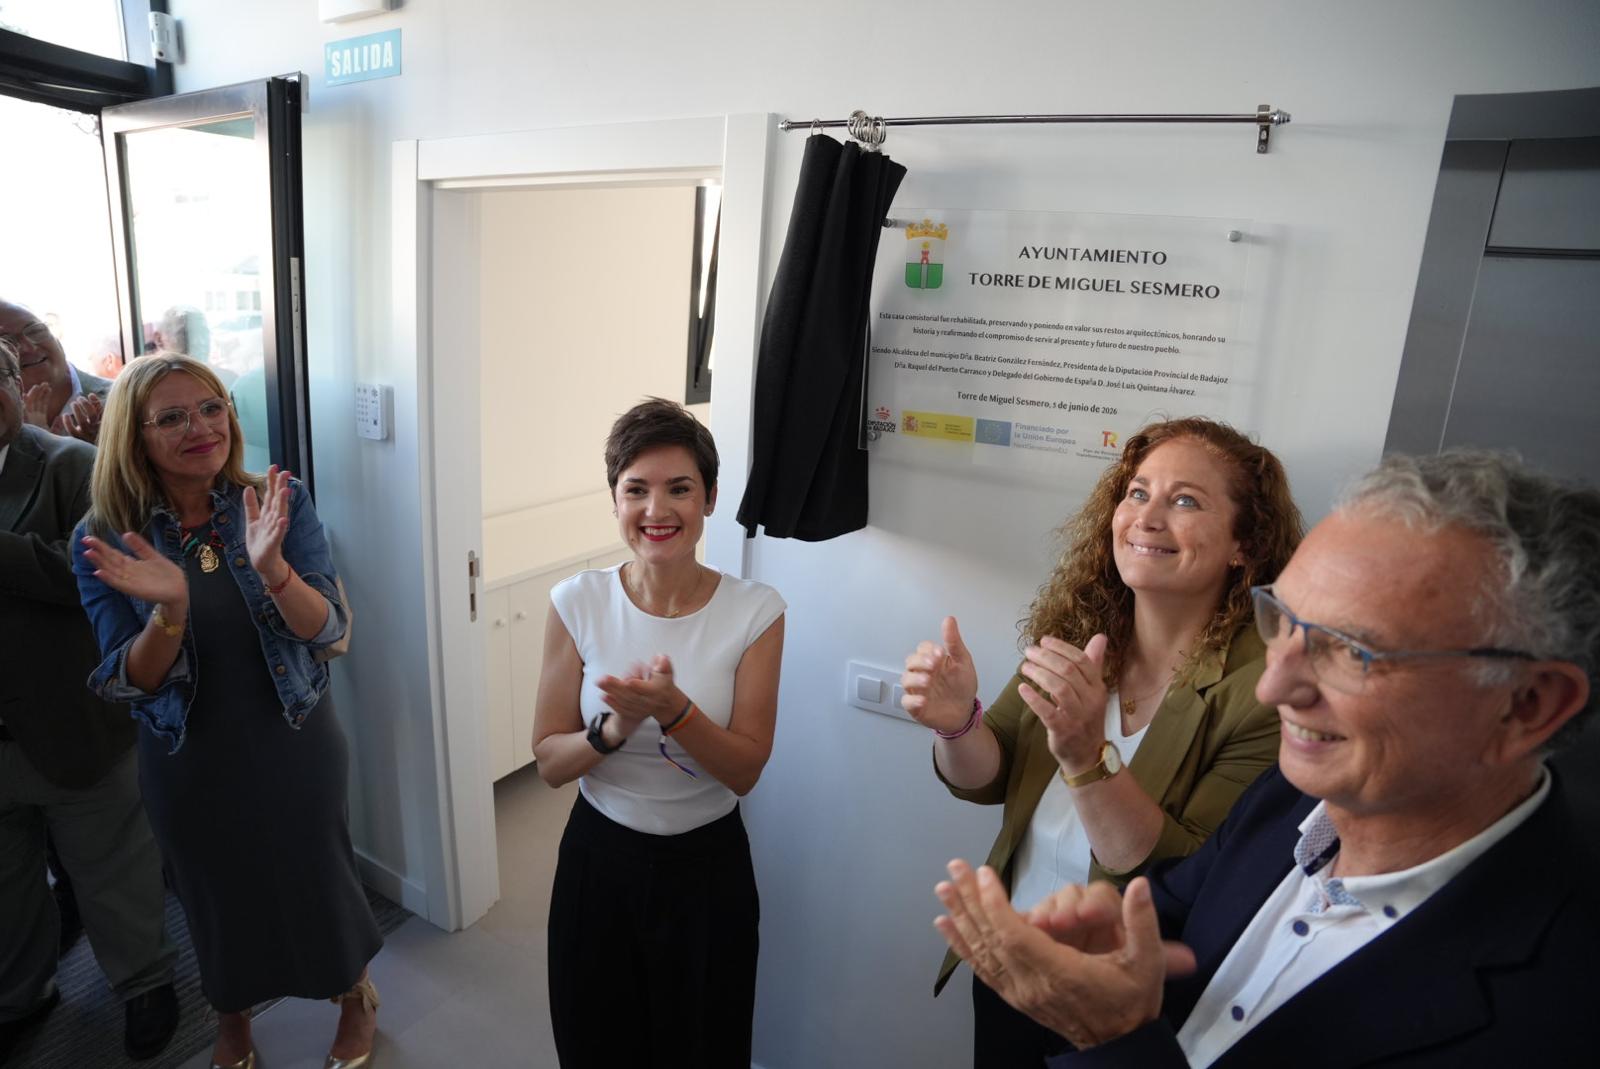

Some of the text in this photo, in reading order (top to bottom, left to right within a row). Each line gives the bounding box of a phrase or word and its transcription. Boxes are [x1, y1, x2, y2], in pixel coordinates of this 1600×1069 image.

[331, 40, 394, 77] SALIDA
[1019, 246, 1167, 266] AYUNTAMIENTO
[968, 272, 1220, 299] TORRE DE MIGUEL SESMERO
[880, 312, 891, 320] Esta
[905, 313, 939, 322] consistorial
[989, 319, 1028, 329] preservando
[1033, 322, 1064, 330] poniendo
[1074, 325, 1091, 333] valor
[1182, 333, 1216, 342] honrando
[913, 327, 936, 336] historia
[941, 329, 977, 338] reafirmando
[985, 332, 1025, 342] compromiso
[1034, 335, 1053, 343] servir
[1060, 339, 1089, 347] presente
[1096, 340, 1117, 349] futuro
[1128, 344, 1154, 352] nuestro
[872, 346, 891, 354] Siendo
[892, 348, 919, 357] Alcaldesa
[920, 350, 930, 358] del
[930, 351, 959, 360] municipio
[974, 354, 996, 362] Beatriz
[997, 356, 1026, 365] González
[1063, 361, 1098, 371] Presidenta
[1099, 363, 1107, 371] de
[1108, 365, 1115, 373] la
[1115, 366, 1153, 376] Diputación
[1154, 369, 1189, 380] Provincial
[1189, 373, 1198, 381] de
[1200, 374, 1228, 384] Badajoz
[908, 363, 928, 372] Raquel
[938, 366, 958, 374] Puerto
[959, 367, 987, 376] Carrasco
[992, 370, 1022, 379] Delegado
[1023, 372, 1033, 380] del
[1033, 374, 1064, 383] Gobierno
[1064, 376, 1073, 384] de
[1074, 378, 1097, 387] España
[1105, 380, 1120, 389] José
[1122, 382, 1136, 390] Luis
[1137, 383, 1168, 393] Quintana
[958, 391, 1118, 416] Torre de Miguel Sesmero, 5 de junio de 2026
[1015, 422, 1056, 433] Financiado
[1022, 432, 1044, 440] Unión
[1045, 435, 1077, 445] Europea
